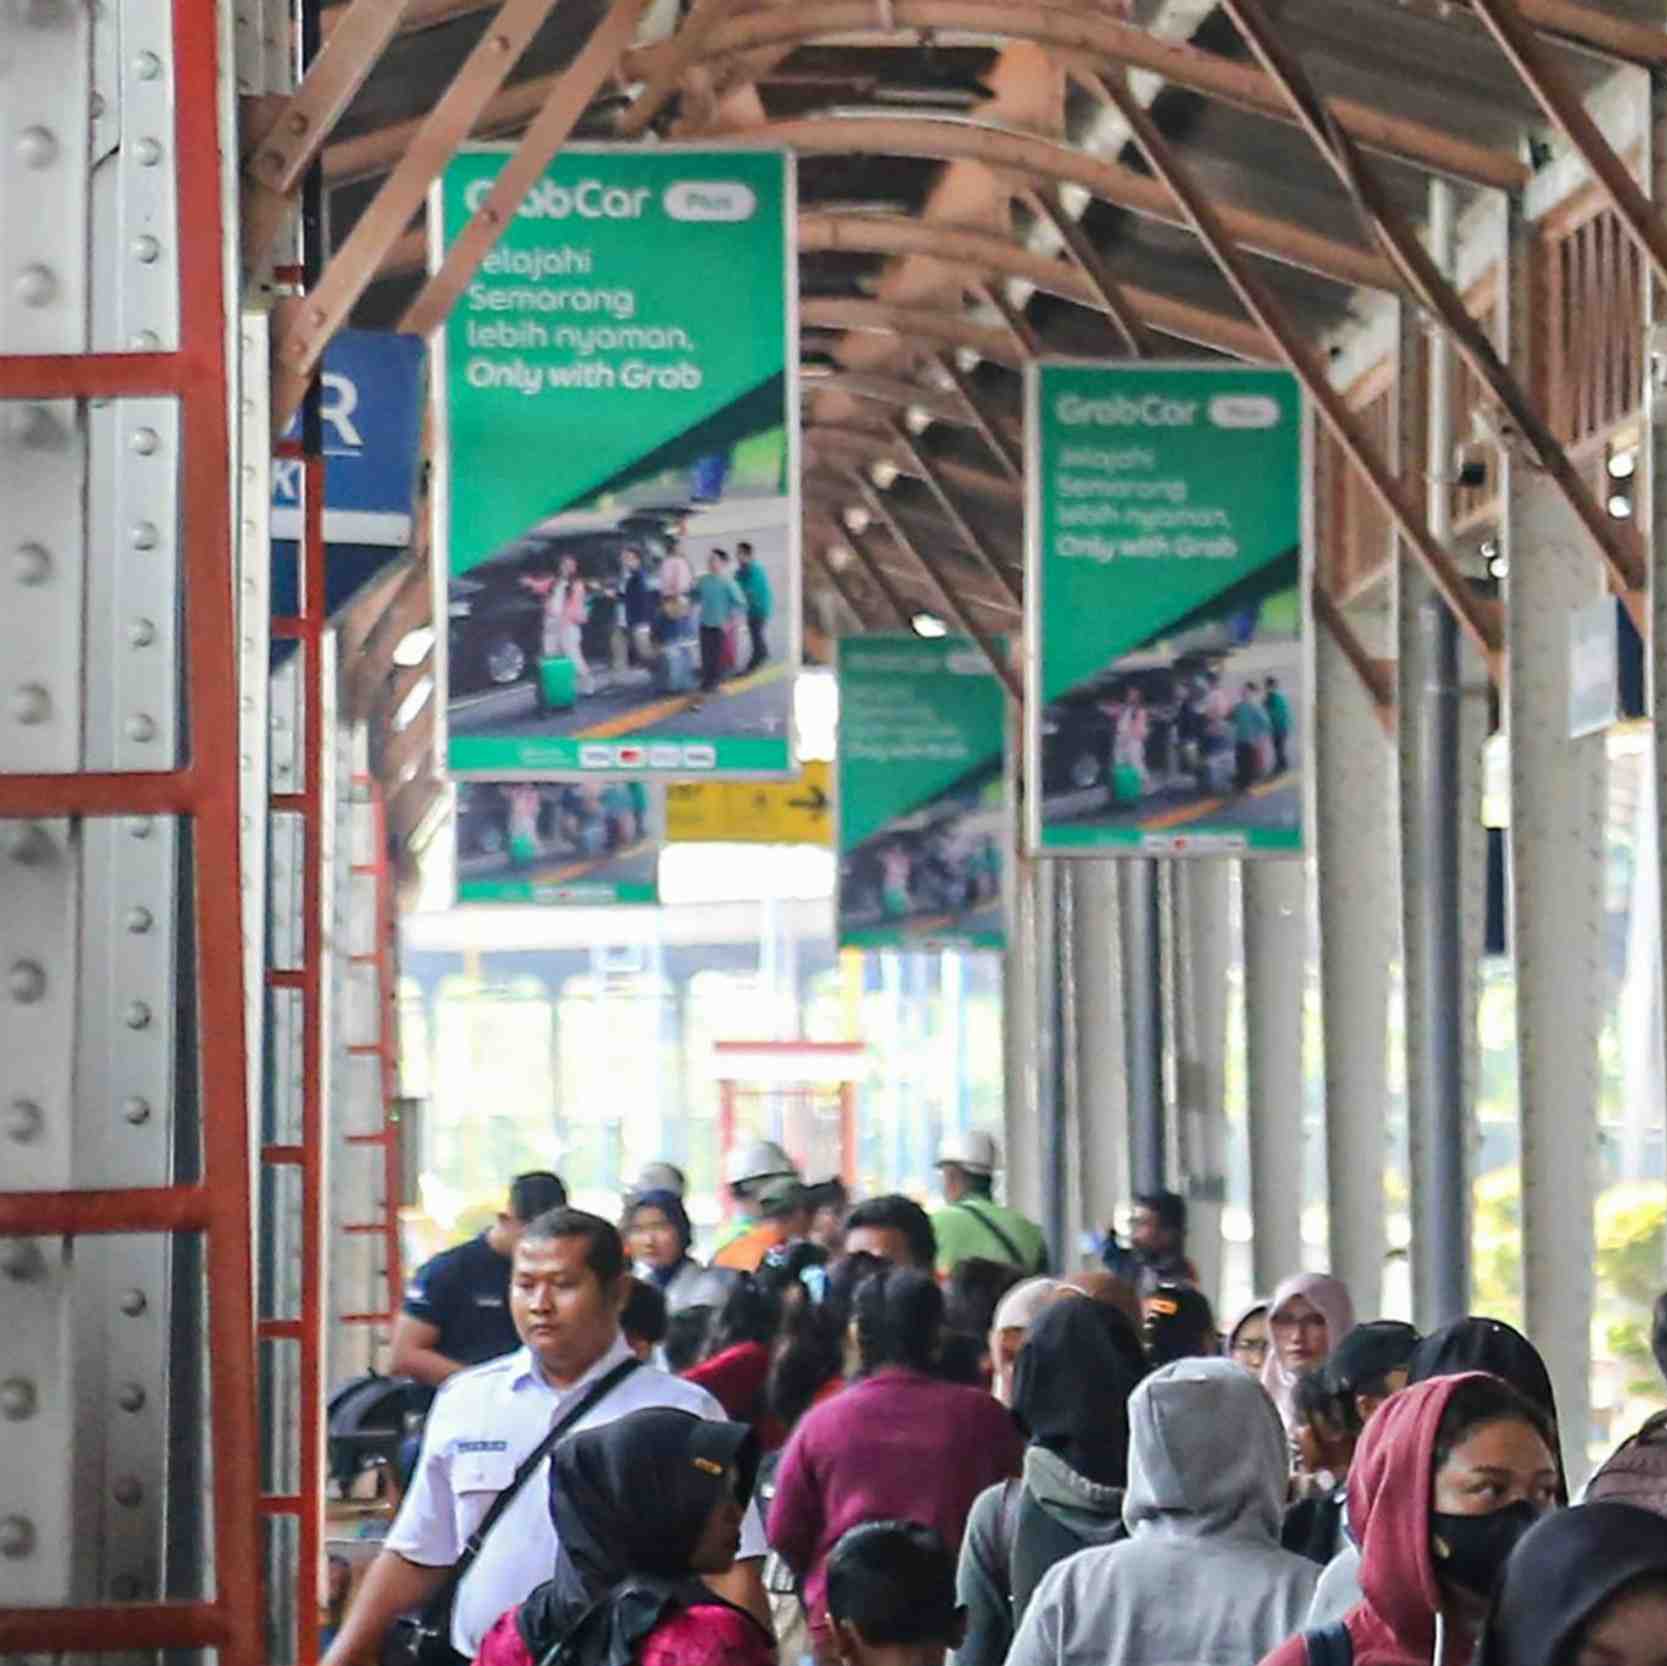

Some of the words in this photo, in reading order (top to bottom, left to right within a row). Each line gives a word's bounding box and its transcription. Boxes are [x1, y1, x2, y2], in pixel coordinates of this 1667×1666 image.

[482, 247, 592, 282] elajahi
[467, 282, 636, 320] Semarang
[466, 319, 548, 349] lebih
[467, 356, 544, 395] Only
[549, 359, 614, 389] with
[620, 360, 702, 391] Grab
[1056, 391, 1198, 426] GrabCar
